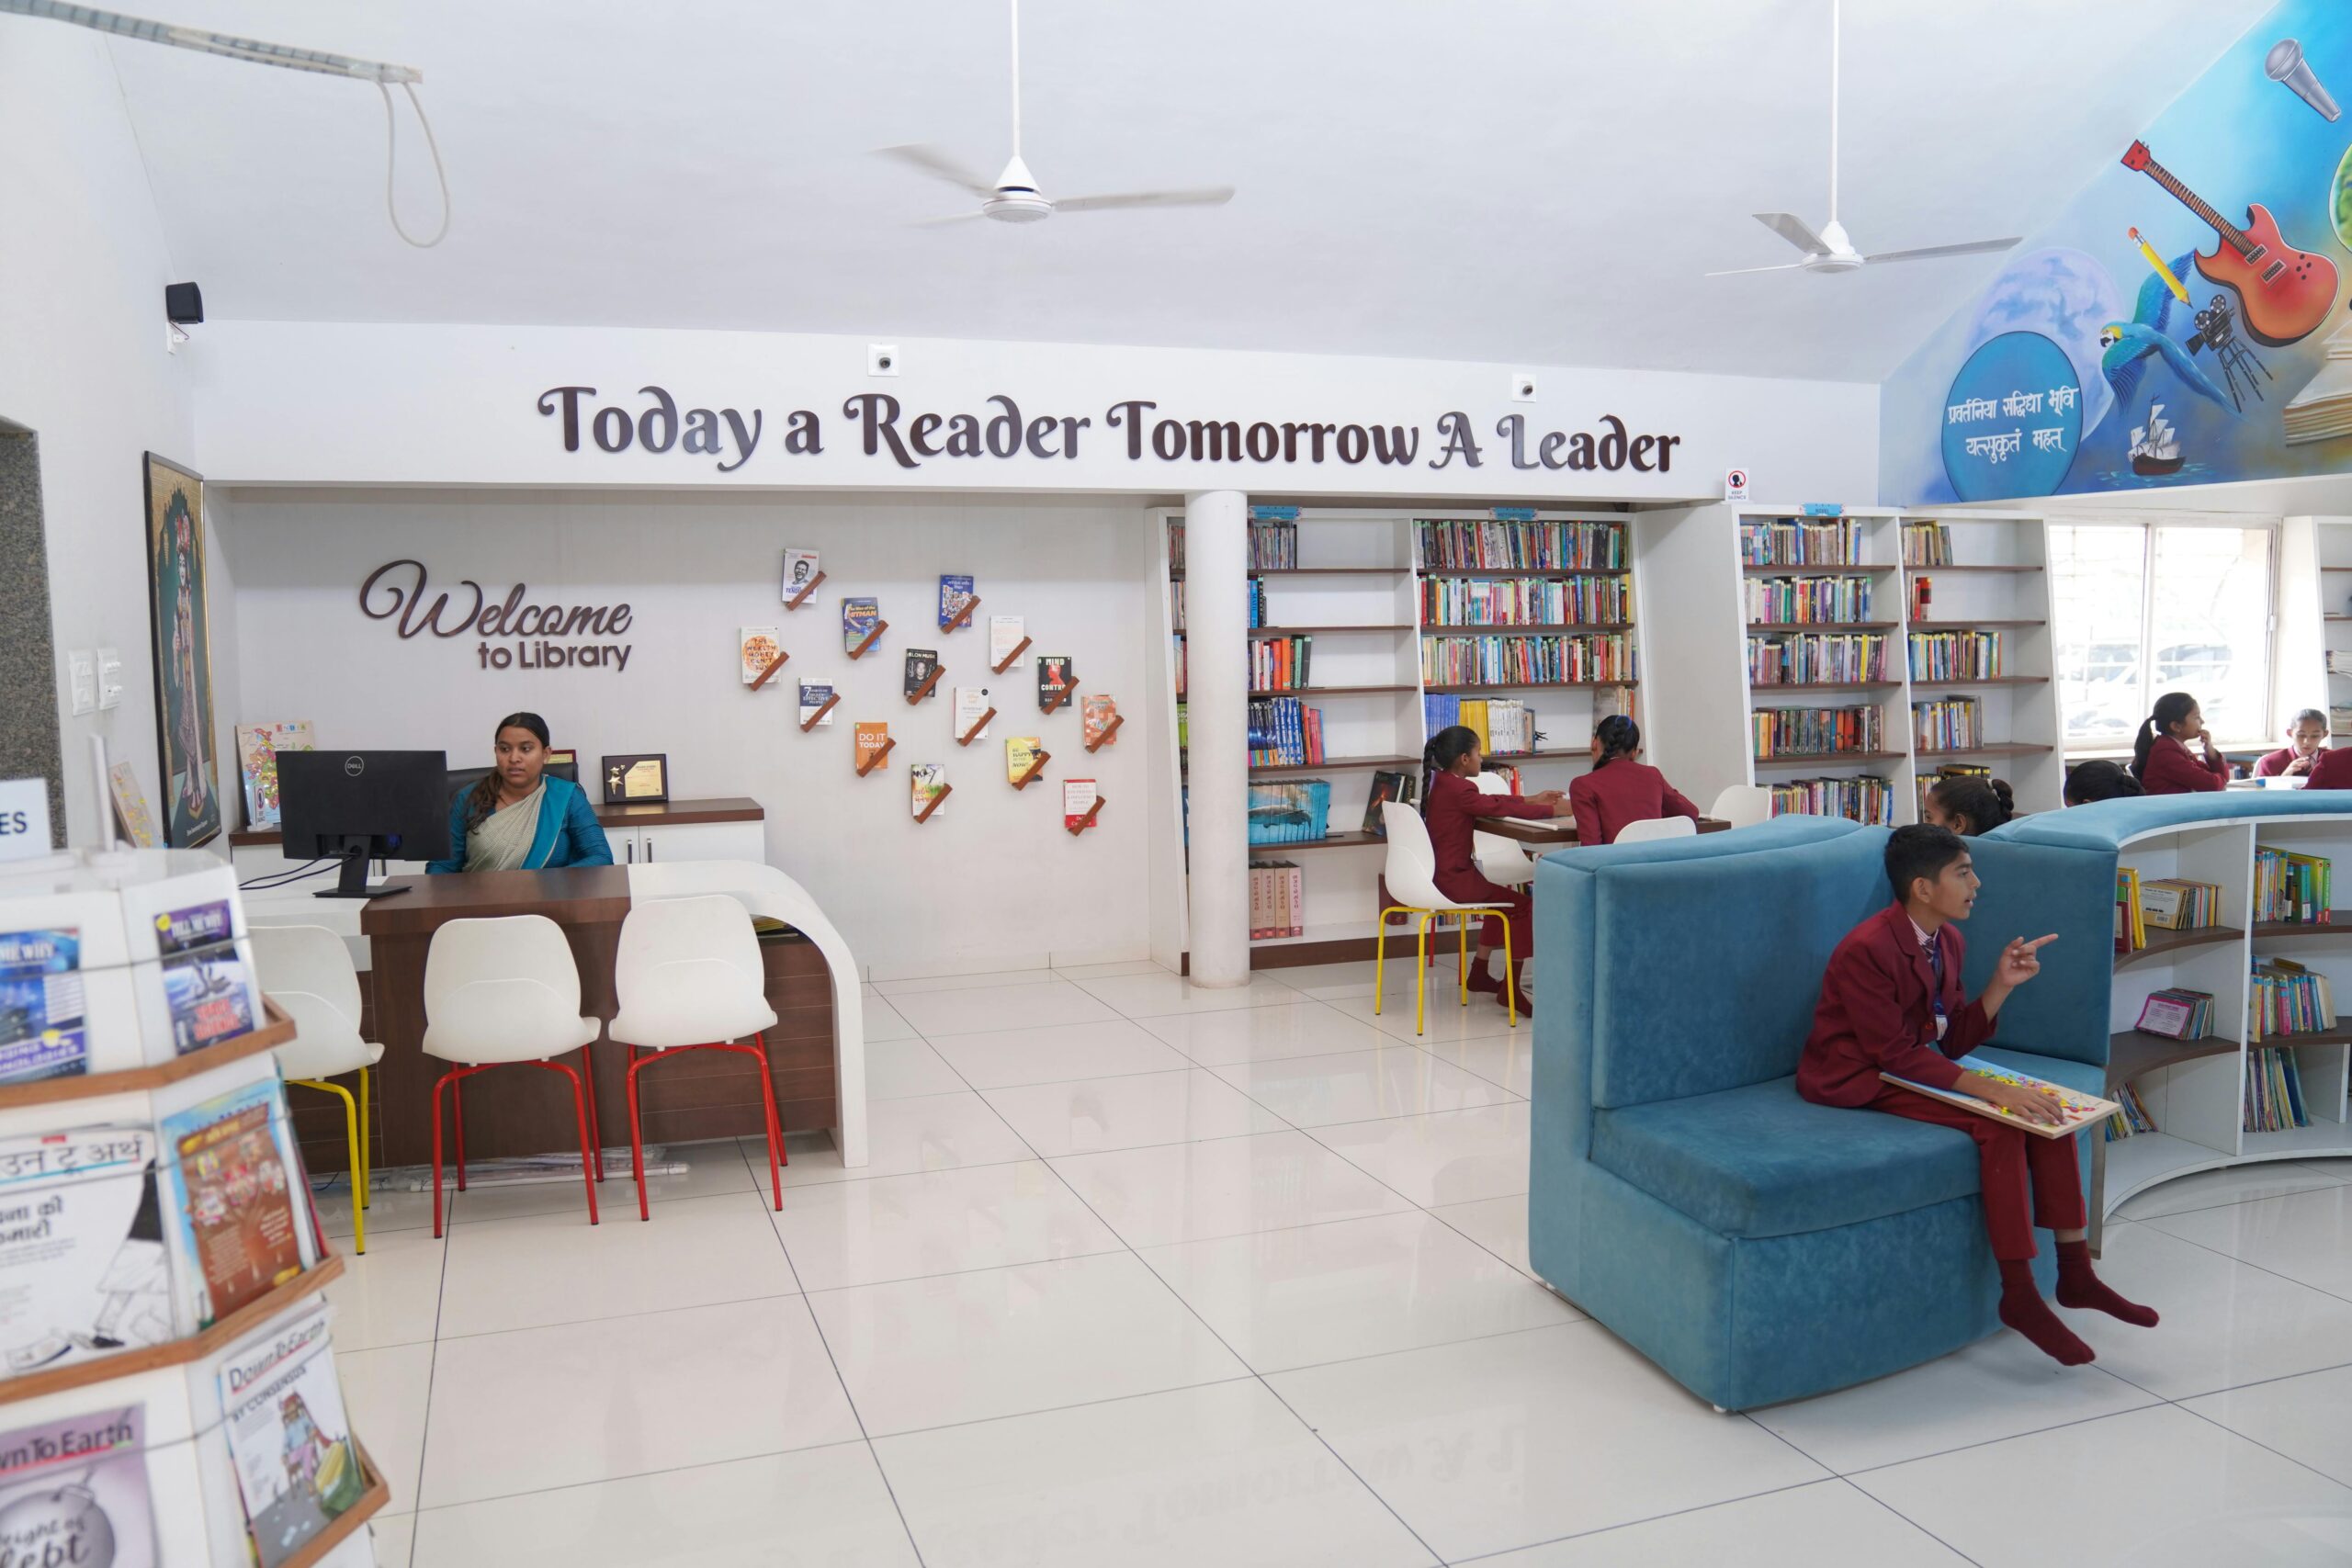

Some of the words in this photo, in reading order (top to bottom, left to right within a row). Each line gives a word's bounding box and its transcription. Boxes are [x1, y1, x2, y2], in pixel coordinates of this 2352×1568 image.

[537, 386, 762, 471] Today
[785, 410, 824, 455] a
[842, 393, 1091, 468] Reader
[1106, 400, 1419, 467] Tomorrow
[1429, 411, 1483, 469] A
[1497, 413, 1680, 472] Leader
[2032, 427, 2067, 452] महत्
[359, 559, 633, 638] Welcome
[478, 642, 512, 669] to
[518, 641, 632, 671] Library
[804, 686, 812, 696] 7
[859, 733, 874, 741] DO
[876, 733, 885, 741] IT
[0, 811, 28, 835] ES
[89, 1135, 142, 1163] अर्थ
[230, 1353, 273, 1393] Down
[288, 1317, 325, 1352] Earth
[29, 1437, 56, 1461] To
[61, 1423, 133, 1456] Earth
